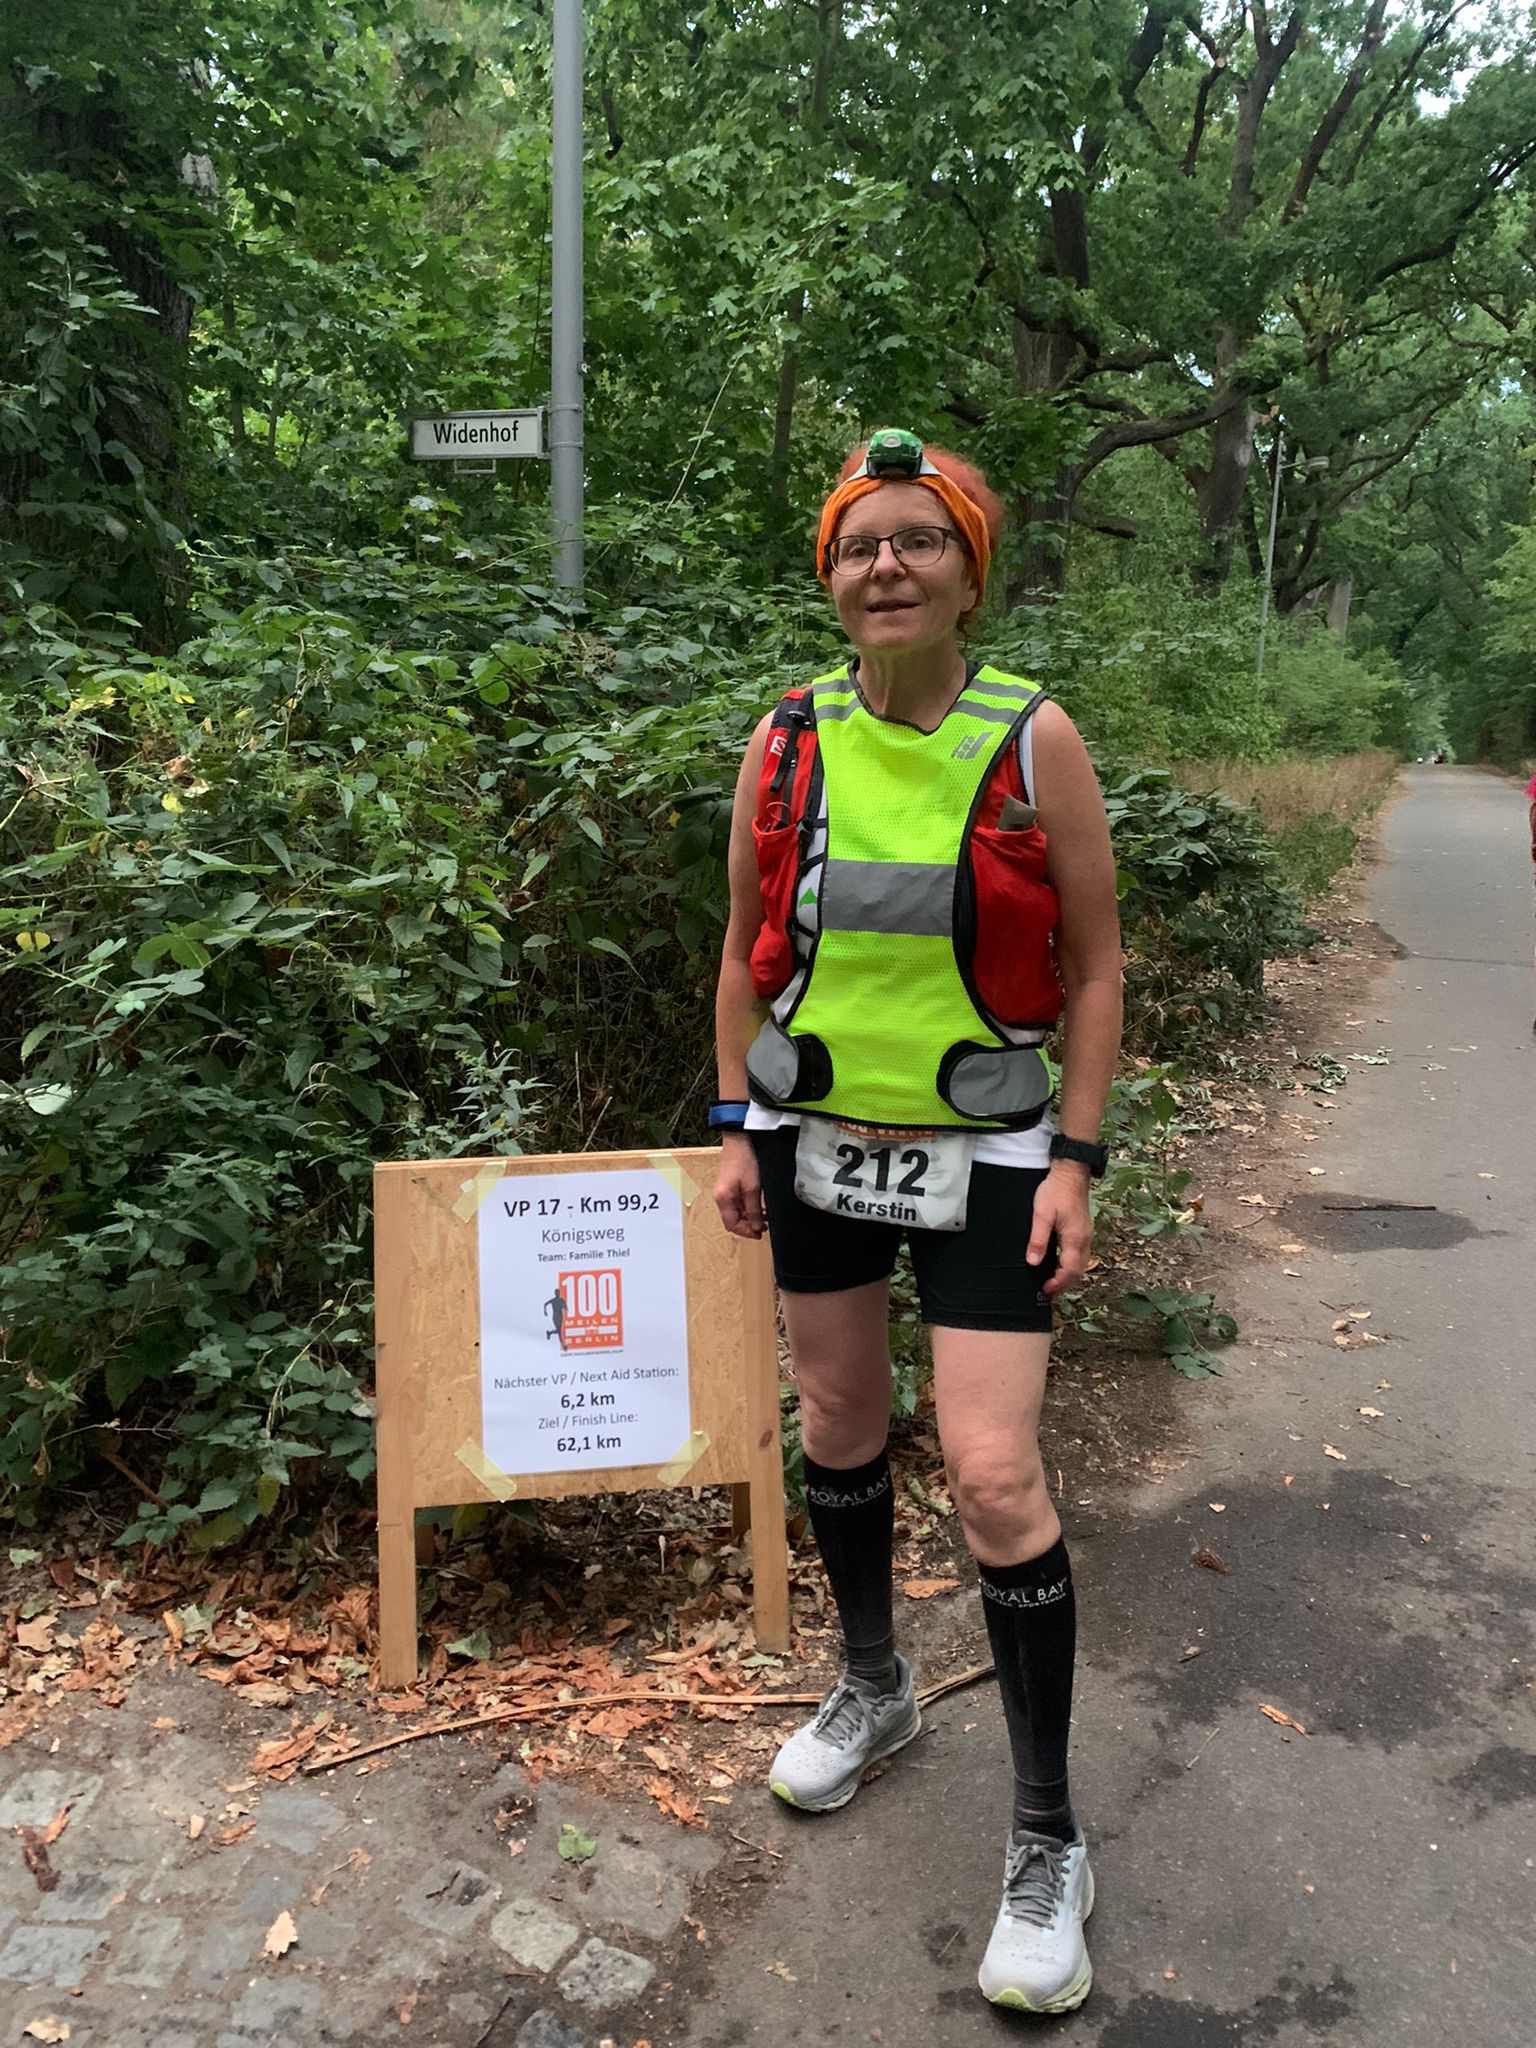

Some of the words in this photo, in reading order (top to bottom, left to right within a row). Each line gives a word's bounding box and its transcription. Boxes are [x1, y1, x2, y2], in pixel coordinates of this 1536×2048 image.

[433, 420, 519, 444] Widenhof
[833, 1143, 929, 1197] 212
[504, 1200, 531, 1218] VP
[538, 1199, 560, 1216] 17
[580, 1196, 611, 1213] Km
[618, 1193, 660, 1213] 99,2
[837, 1193, 917, 1222] Kerstin
[541, 1226, 625, 1245] Königsweg
[537, 1252, 567, 1263] Team:
[569, 1250, 604, 1261] Familie
[607, 1248, 630, 1259] Thiel
[562, 1272, 618, 1318] 100
[565, 1317, 618, 1327] MEILEN
[565, 1335, 618, 1345] BERLIN
[494, 1374, 548, 1390] Nächster
[551, 1373, 567, 1386] VP
[570, 1371, 577, 1386] /
[580, 1371, 607, 1383] Next
[610, 1368, 630, 1381] Aid
[633, 1365, 679, 1379] Station:
[560, 1393, 585, 1410] 6,2
[590, 1392, 615, 1407] km
[538, 1416, 560, 1430] Ziel
[562, 1415, 568, 1430] /
[572, 1413, 607, 1427] Finish
[610, 1411, 638, 1425] Line:
[557, 1435, 591, 1454] 62,1
[597, 1434, 621, 1450] km
[983, 1582, 1031, 1604] OYAL
